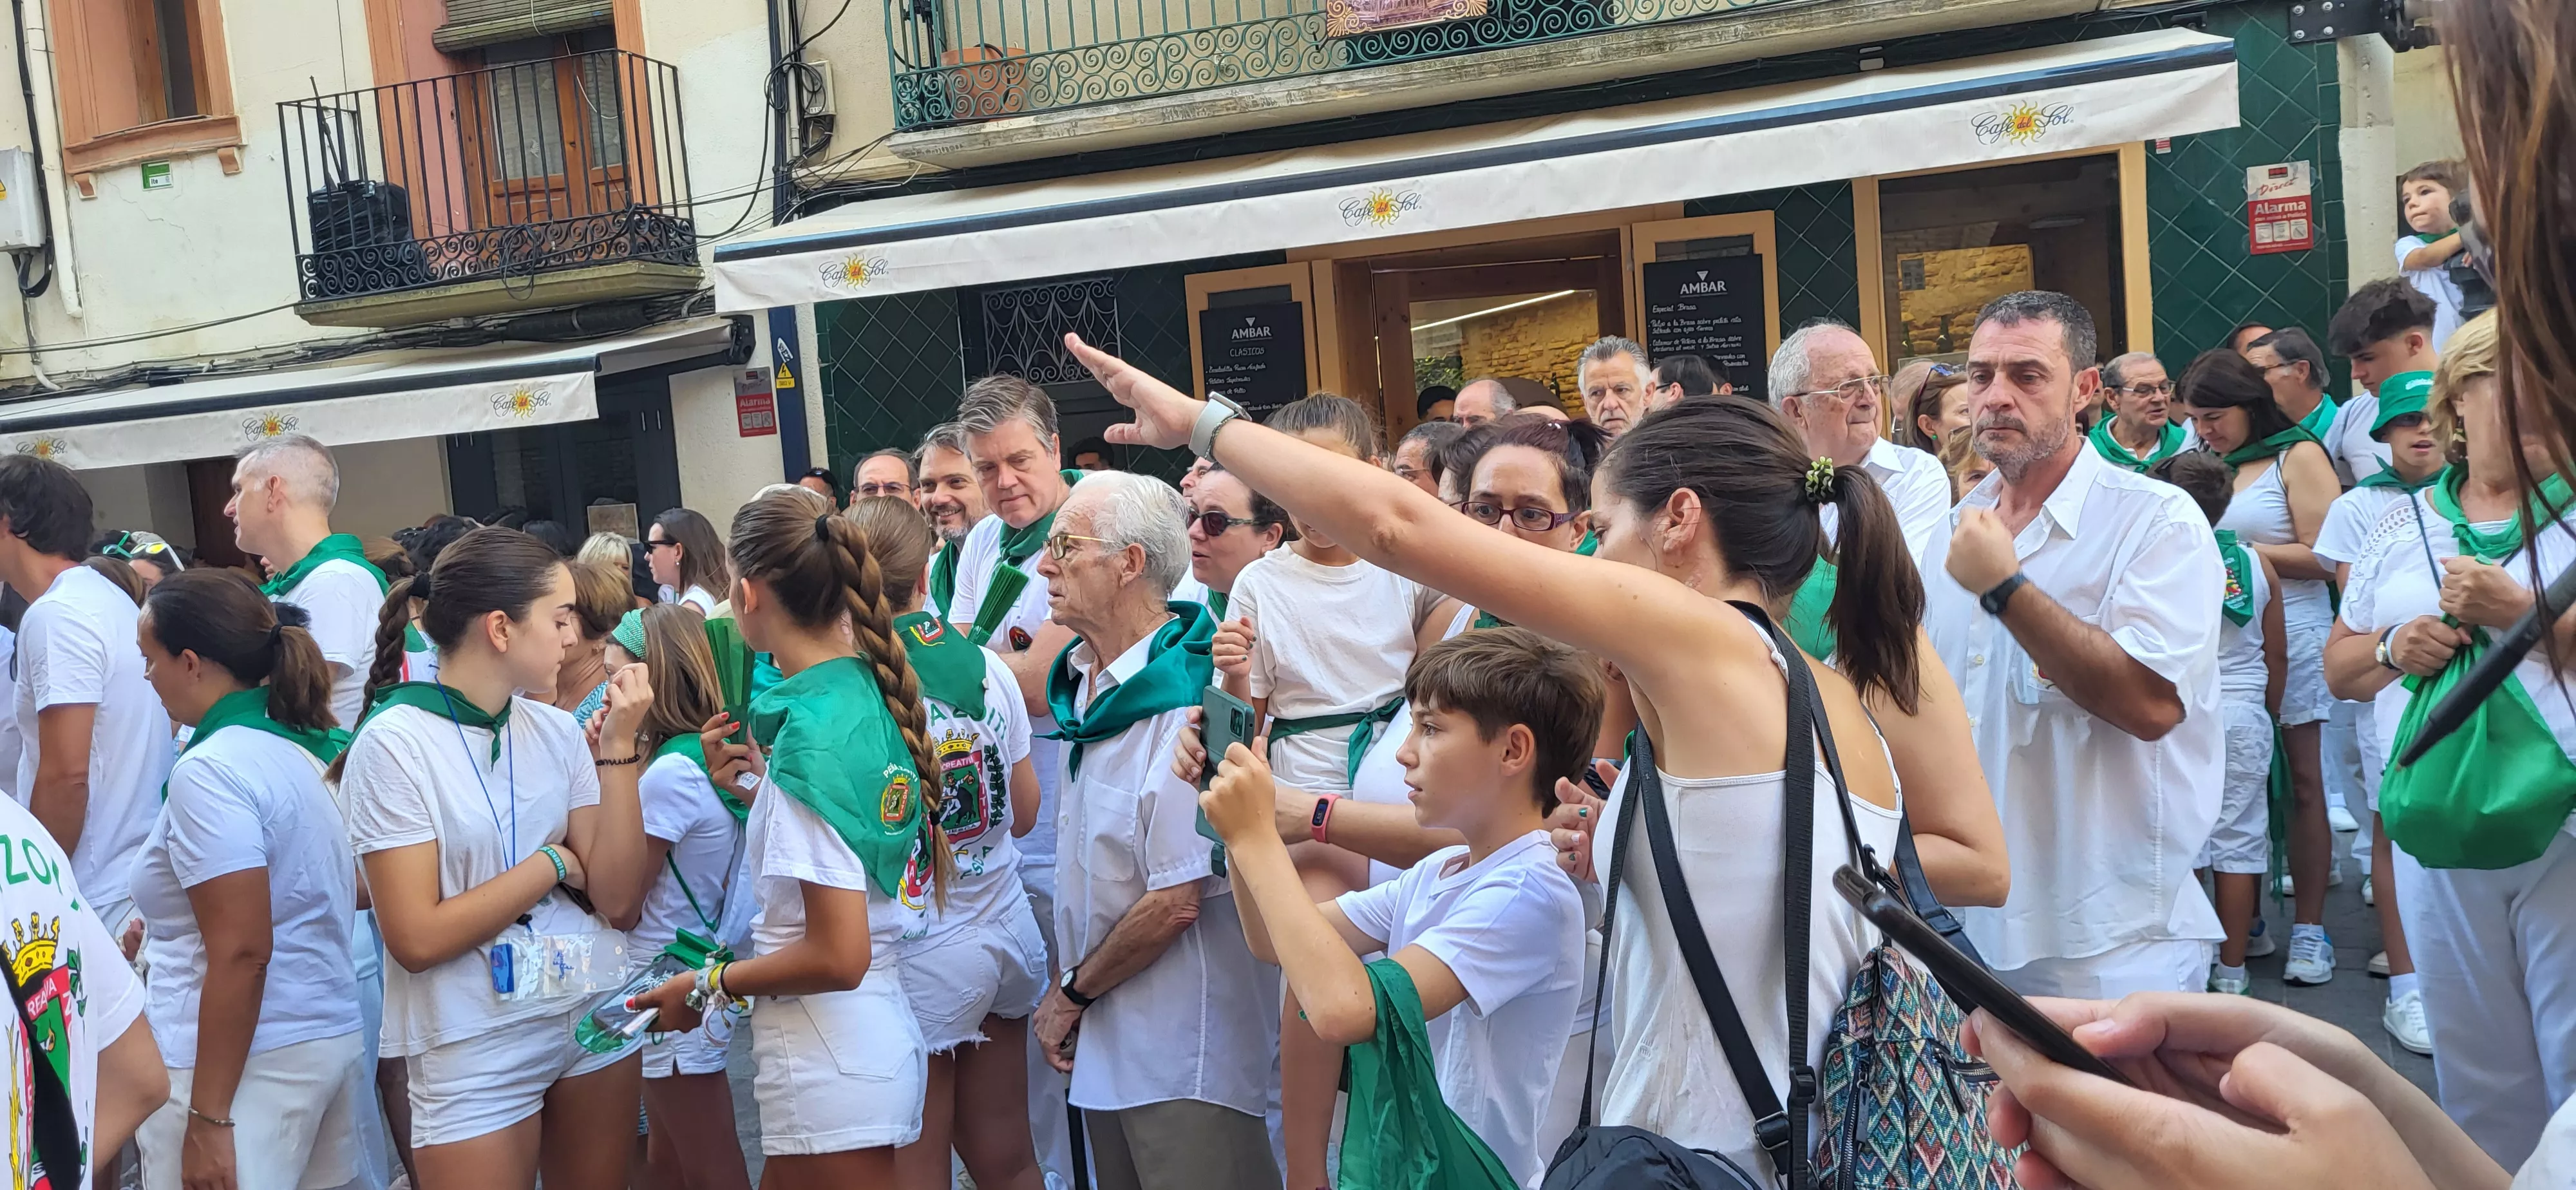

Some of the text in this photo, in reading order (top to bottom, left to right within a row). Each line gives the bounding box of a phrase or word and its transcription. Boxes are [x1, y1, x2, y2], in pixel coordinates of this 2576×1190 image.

[2255, 201, 2307, 215] Alarma
[1680, 280, 1727, 295] AMBAR
[1652, 305, 1674, 314] Especial
[1231, 326, 1272, 340] AMBAR
[1229, 347, 1265, 357] CLASICOS
[740, 397, 771, 408] Alarma
